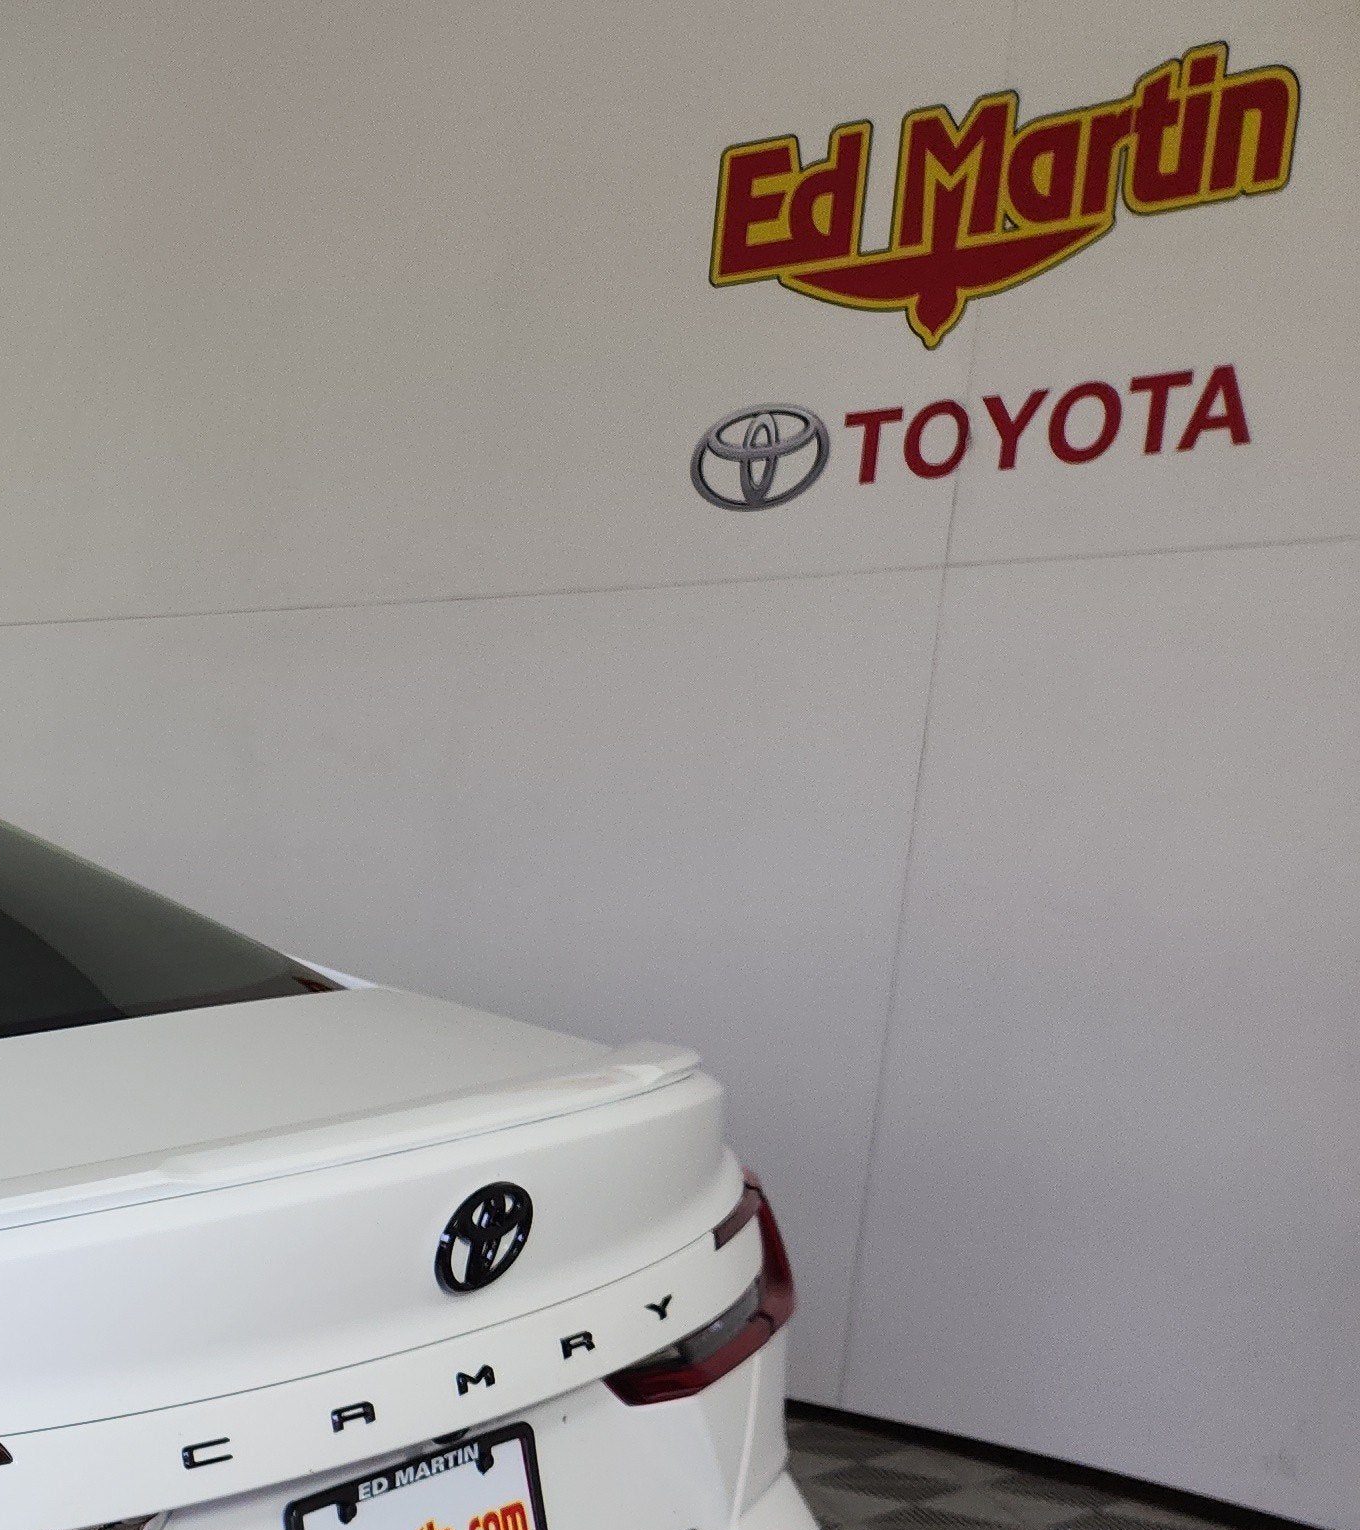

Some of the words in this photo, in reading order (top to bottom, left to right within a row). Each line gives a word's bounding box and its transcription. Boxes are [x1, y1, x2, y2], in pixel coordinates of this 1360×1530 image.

[709, 120, 872, 287] Ed
[890, 40, 1302, 256] Martin
[844, 364, 1251, 486] TOYOTA
[181, 1294, 673, 1469] CAMRY
[358, 1475, 389, 1501] ED
[394, 1442, 481, 1487] MARTIN
